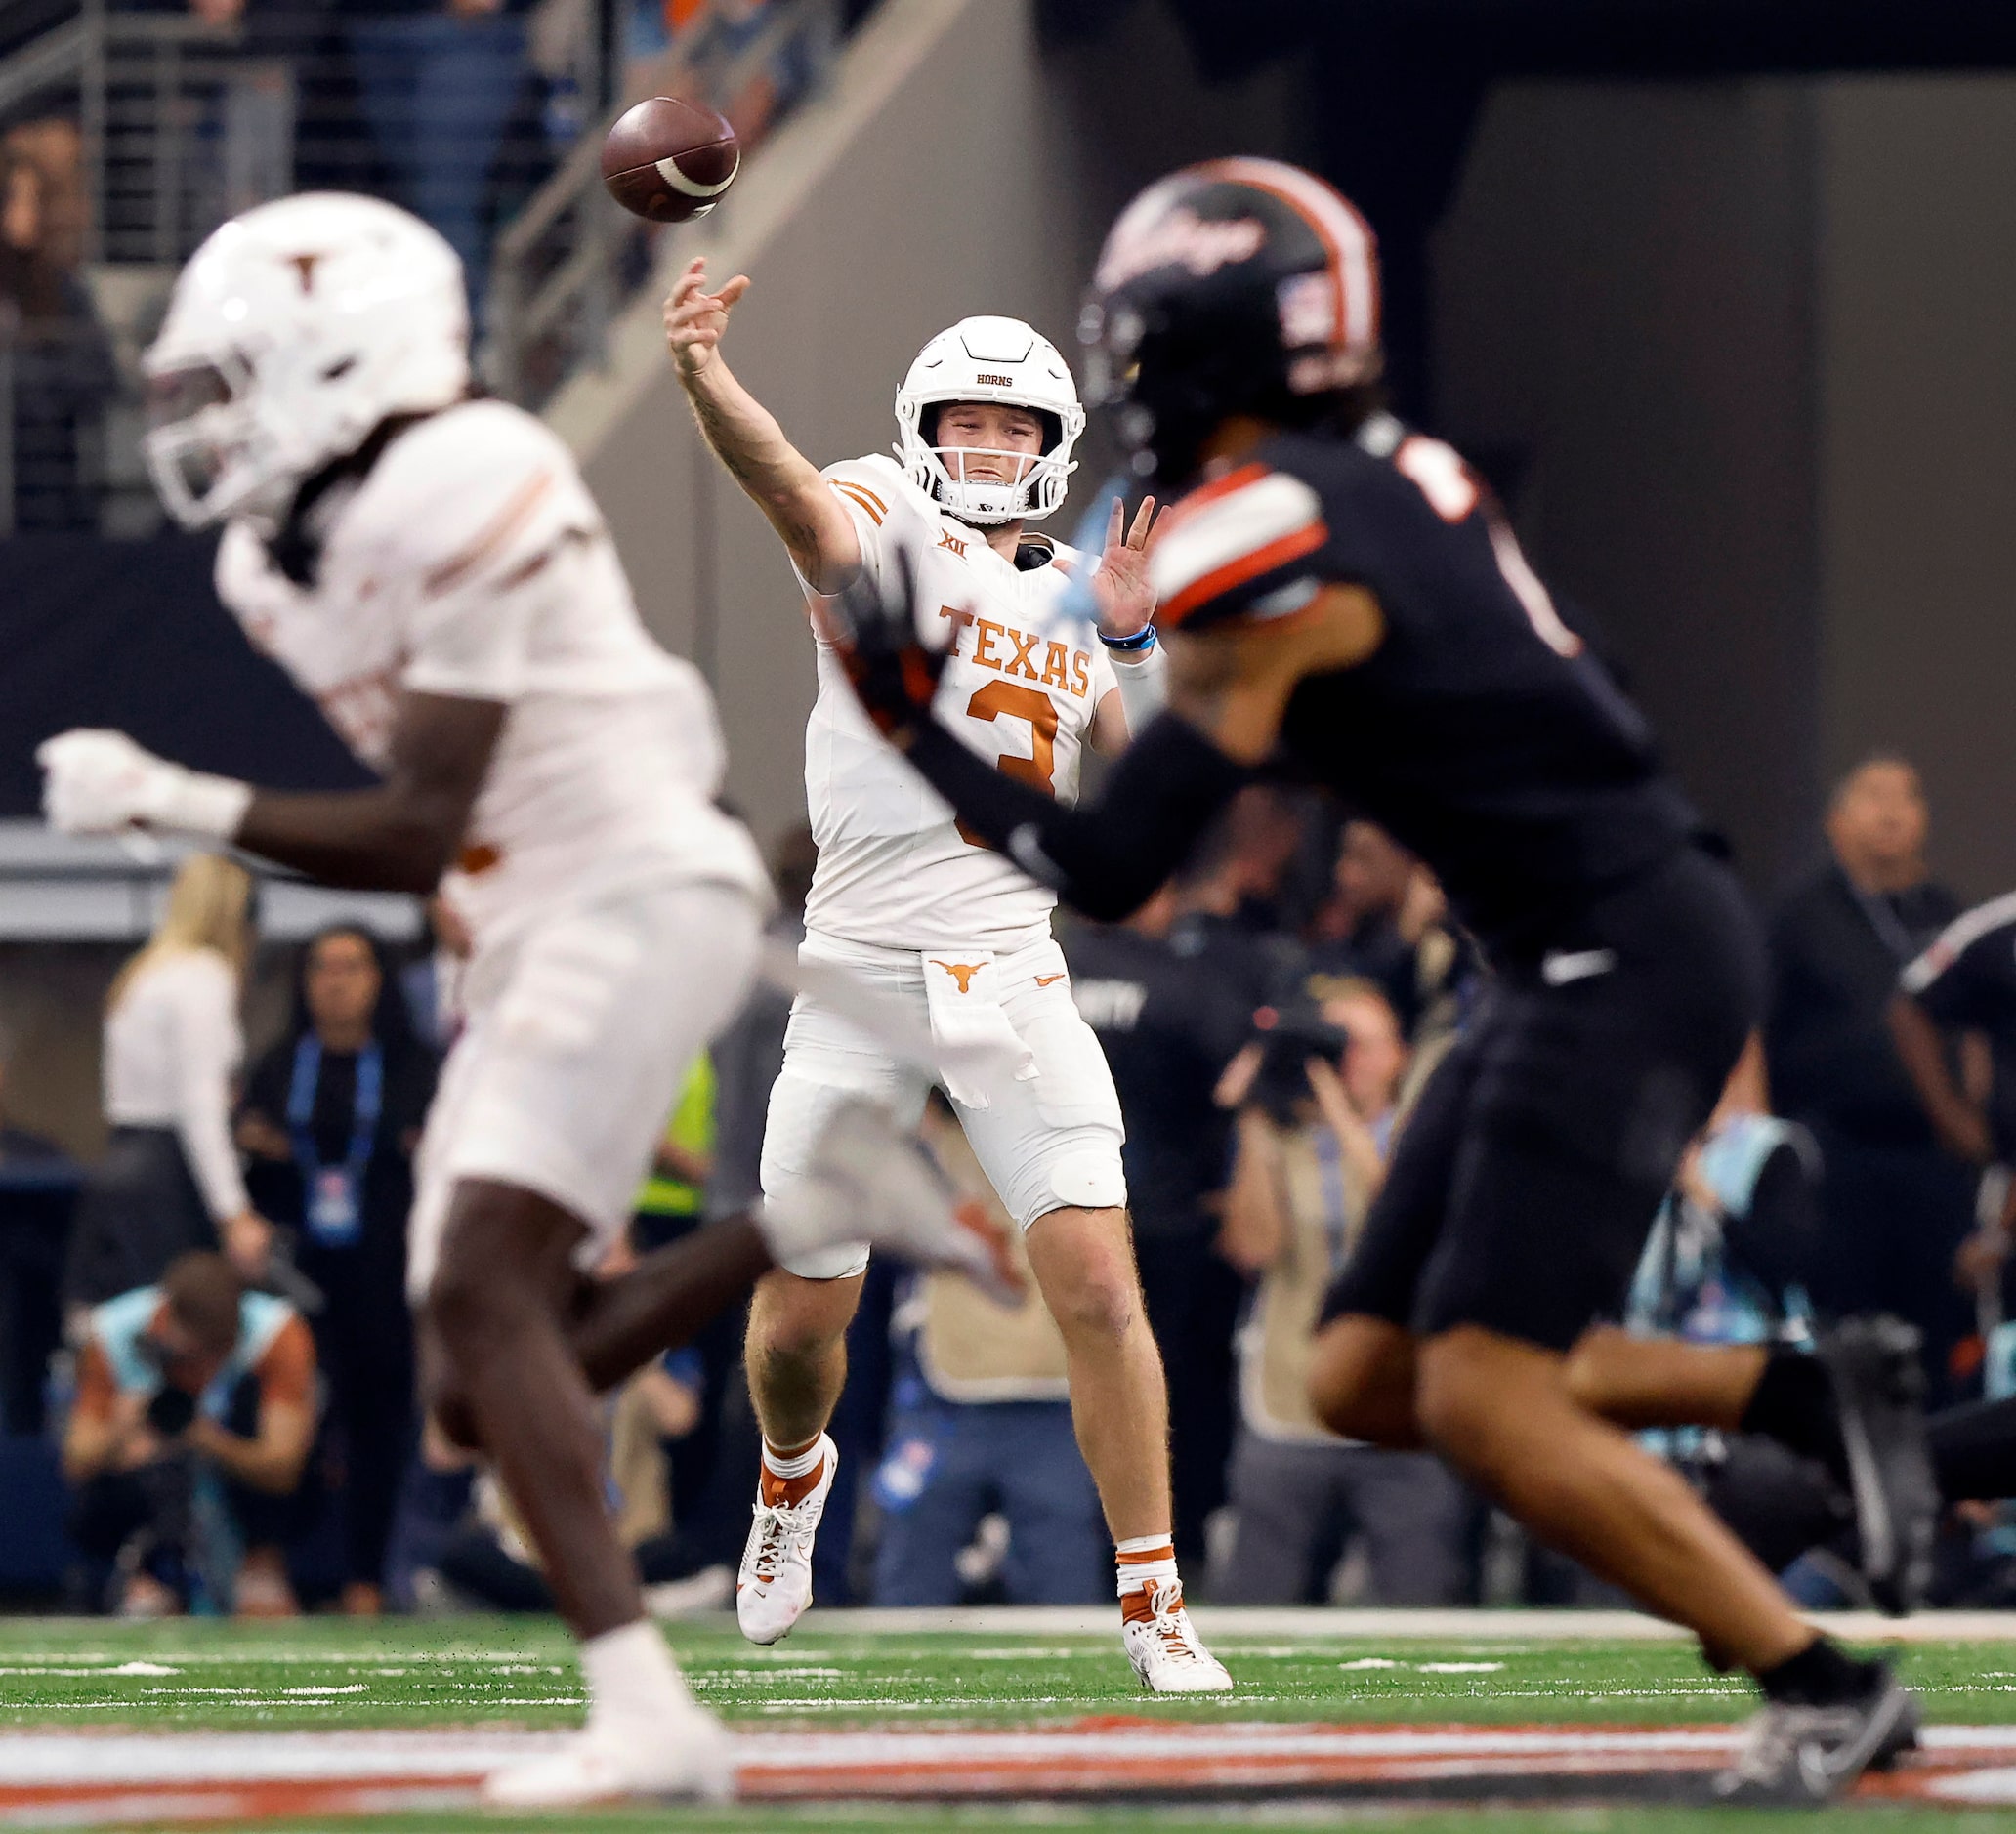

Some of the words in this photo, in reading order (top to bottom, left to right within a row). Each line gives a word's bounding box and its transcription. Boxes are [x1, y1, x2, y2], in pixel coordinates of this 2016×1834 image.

[977, 374, 1013, 387] HORNS
[937, 527, 969, 560] XII
[939, 604, 1092, 699] TEXAS
